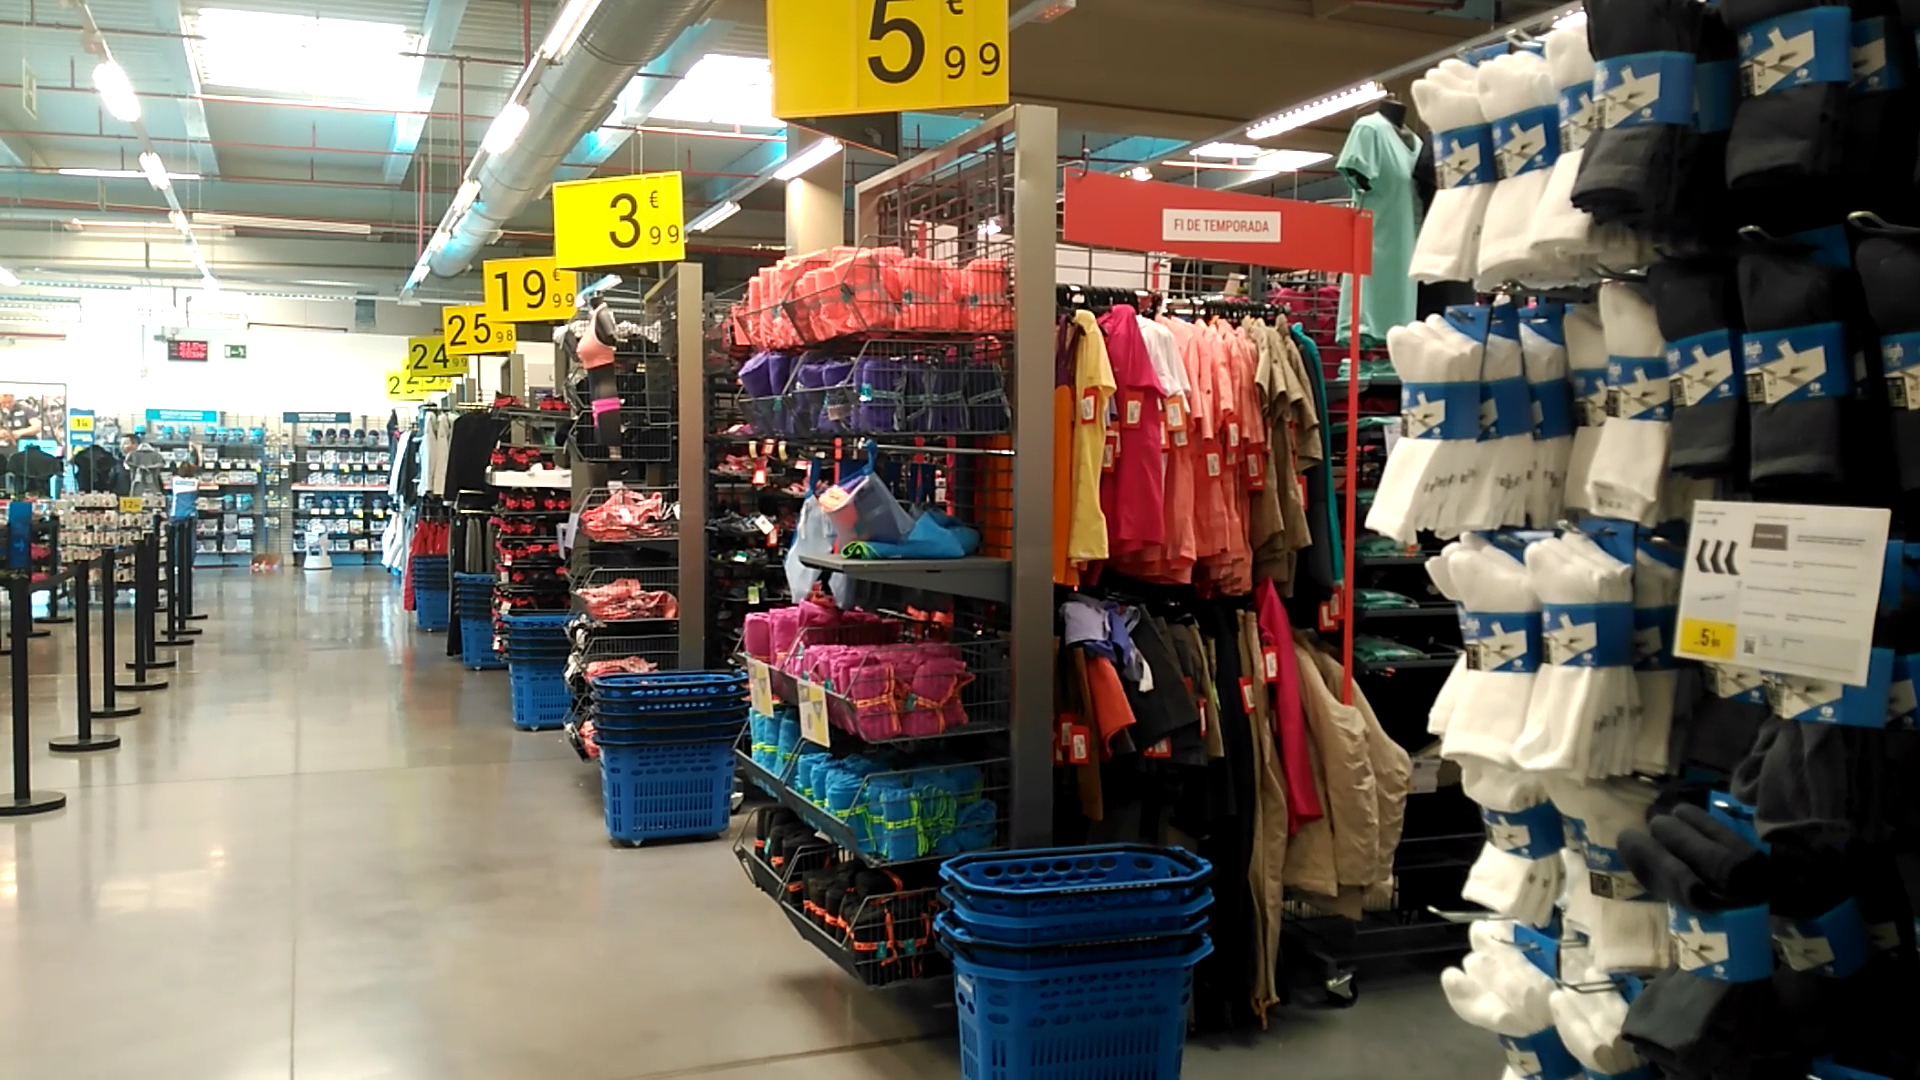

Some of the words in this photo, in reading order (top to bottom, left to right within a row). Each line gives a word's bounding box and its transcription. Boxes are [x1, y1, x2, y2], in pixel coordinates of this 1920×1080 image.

[867, 0, 926, 84] 5
[609, 192, 641, 249] 3
[1173, 218, 1184, 231] FI
[1187, 218, 1201, 232] DE
[1203, 219, 1270, 233] TEMPORADA
[494, 269, 546, 312] 19
[448, 313, 491, 347] 25
[411, 343, 450, 370] 24
